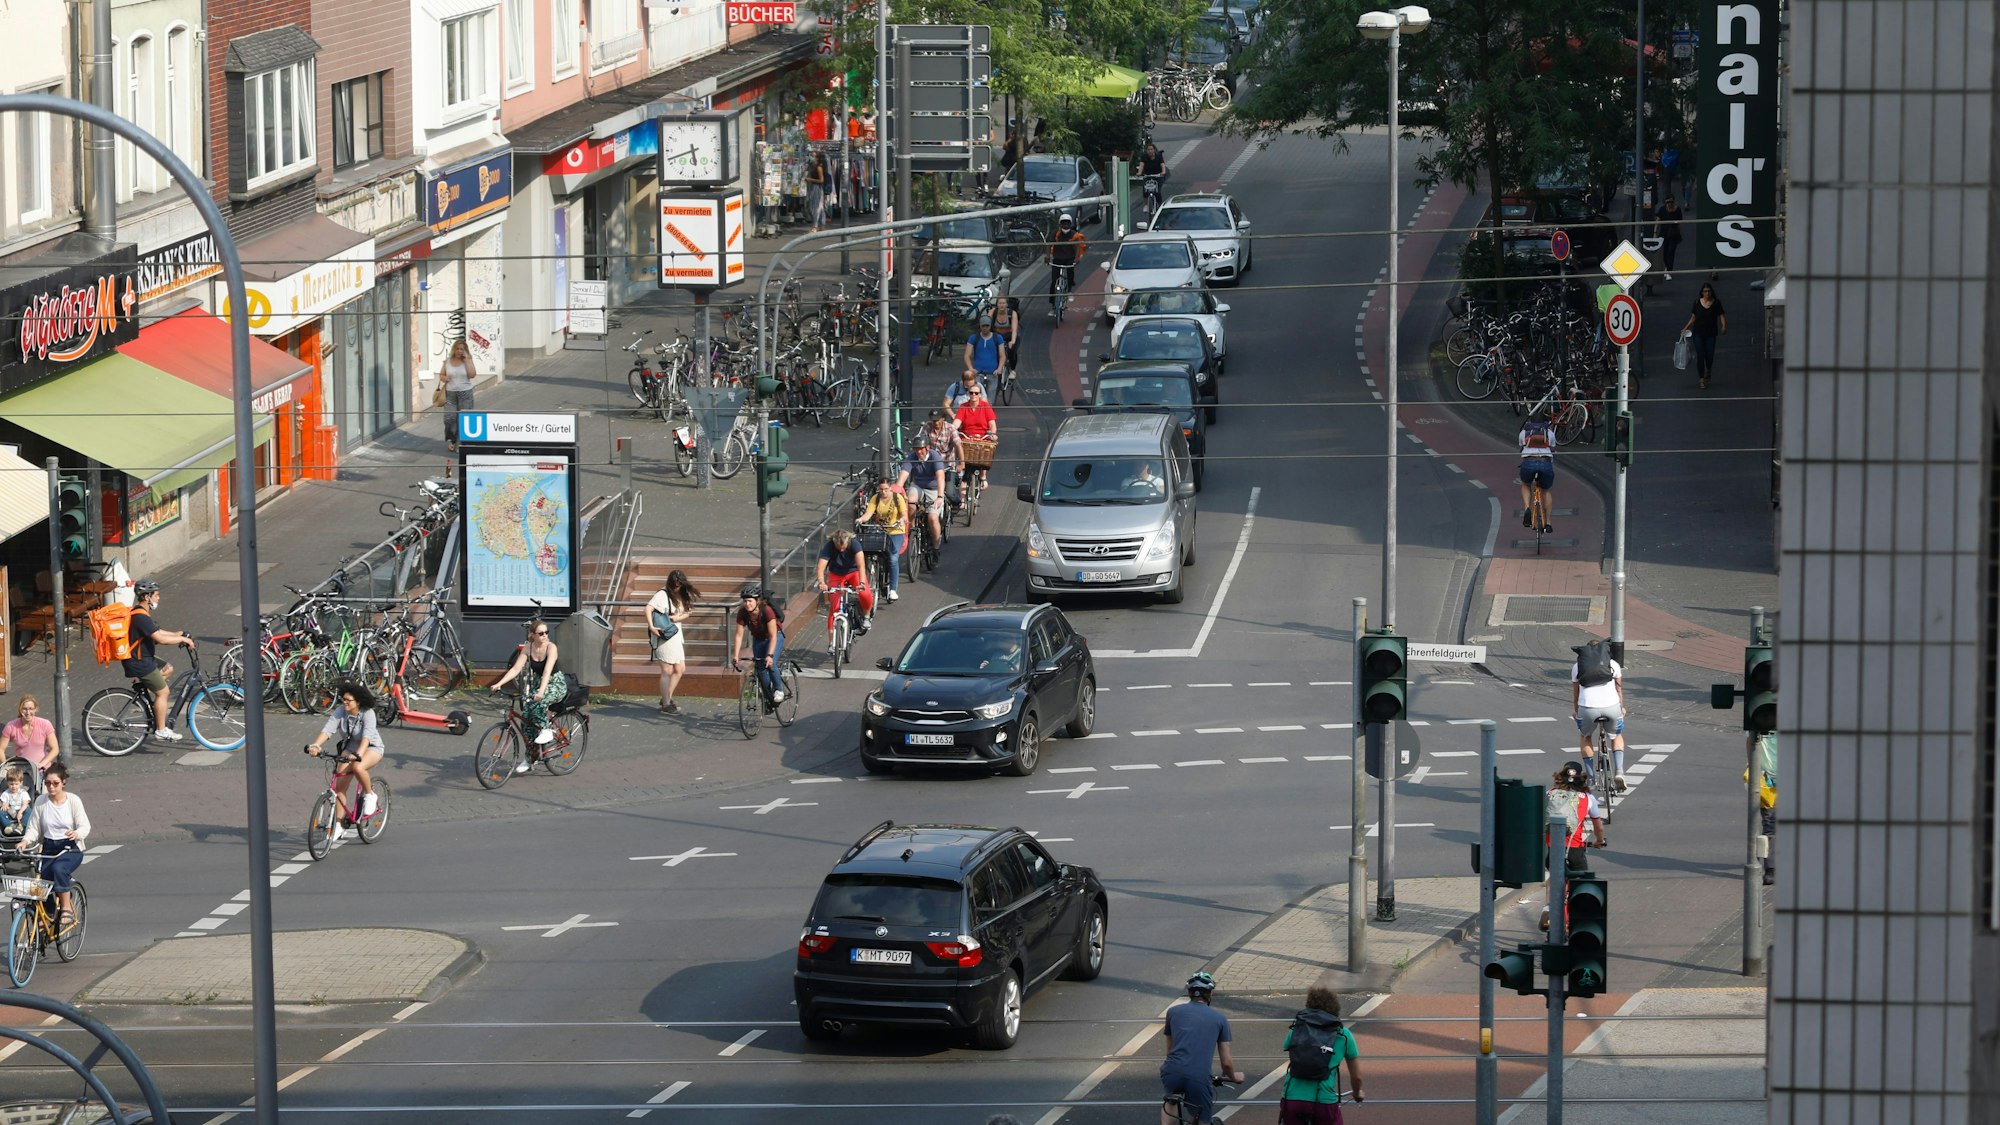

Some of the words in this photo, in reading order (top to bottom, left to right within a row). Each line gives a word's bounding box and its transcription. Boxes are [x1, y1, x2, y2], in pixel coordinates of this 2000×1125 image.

[728, 4, 794, 22] BÜCHER
[663, 206, 673, 215] Zu
[675, 207, 712, 216] vermieten
[186, 234, 221, 276] KEBA
[665, 268, 674, 276] Zu
[676, 268, 713, 277] vermieten
[302, 258, 351, 309] Merzenich
[1611, 307, 1632, 332] 30
[463, 415, 483, 438] U
[492, 423, 523, 433] Venloer
[1407, 646, 1476, 660] Ehrenfeldgürtel
[910, 735, 919, 744] WI
[924, 735, 934, 744] TL
[935, 736, 953, 744] 5632
[857, 950, 865, 960] K
[869, 951, 883, 961] MT
[885, 951, 911, 962] 9097
